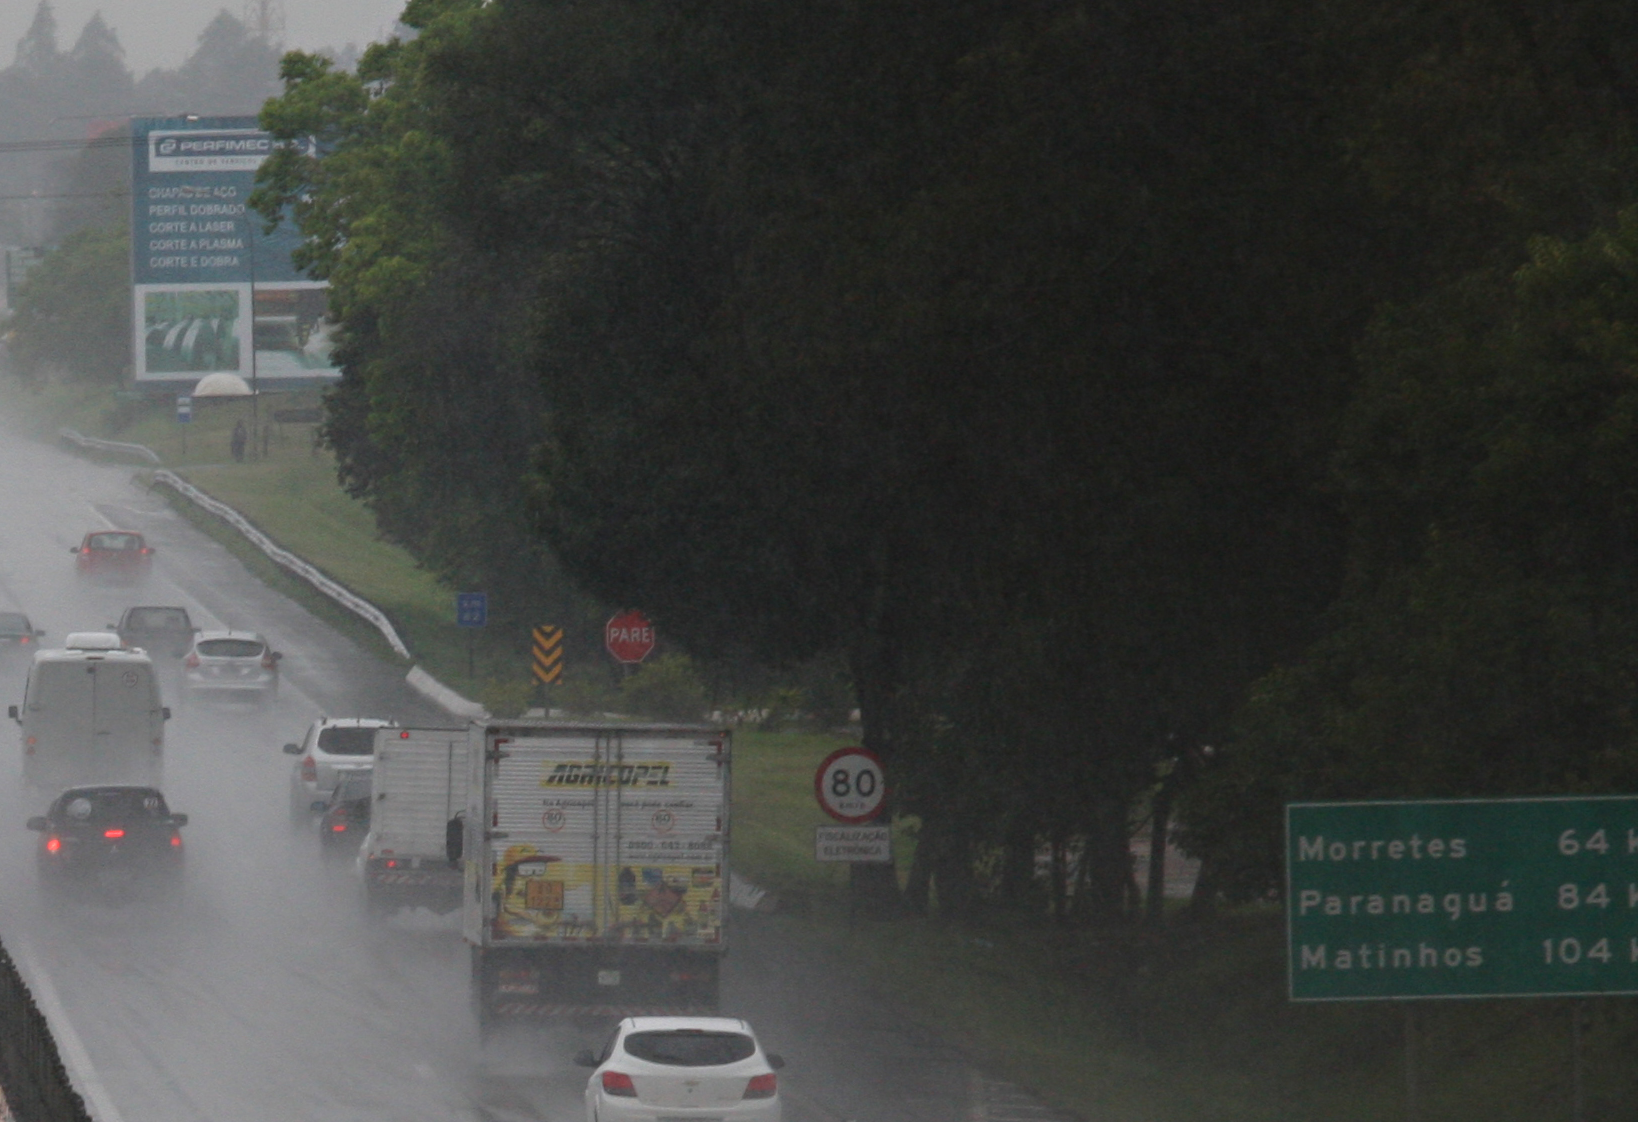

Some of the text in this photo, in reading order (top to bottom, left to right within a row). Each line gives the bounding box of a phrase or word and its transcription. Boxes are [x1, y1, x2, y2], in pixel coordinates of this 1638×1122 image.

[149, 203, 246, 216] PERFIL DOBRADO
[149, 221, 235, 233] CORTE A LASER
[149, 238, 244, 251] CORTE A PLASMA
[150, 256, 240, 268] CORTE E DOBRA
[609, 629, 650, 643] PARE
[546, 764, 671, 786] AGRICOPEL
[832, 769, 875, 797] 80
[818, 831, 888, 843] FISCALIZAÇÃO
[1298, 834, 1468, 862] Morretes
[1558, 828, 1610, 856] 64
[1299, 879, 1514, 921] Paranaguá
[1558, 882, 1611, 911] 84
[1300, 942, 1484, 970] Matinhos
[1541, 937, 1612, 965] 104
